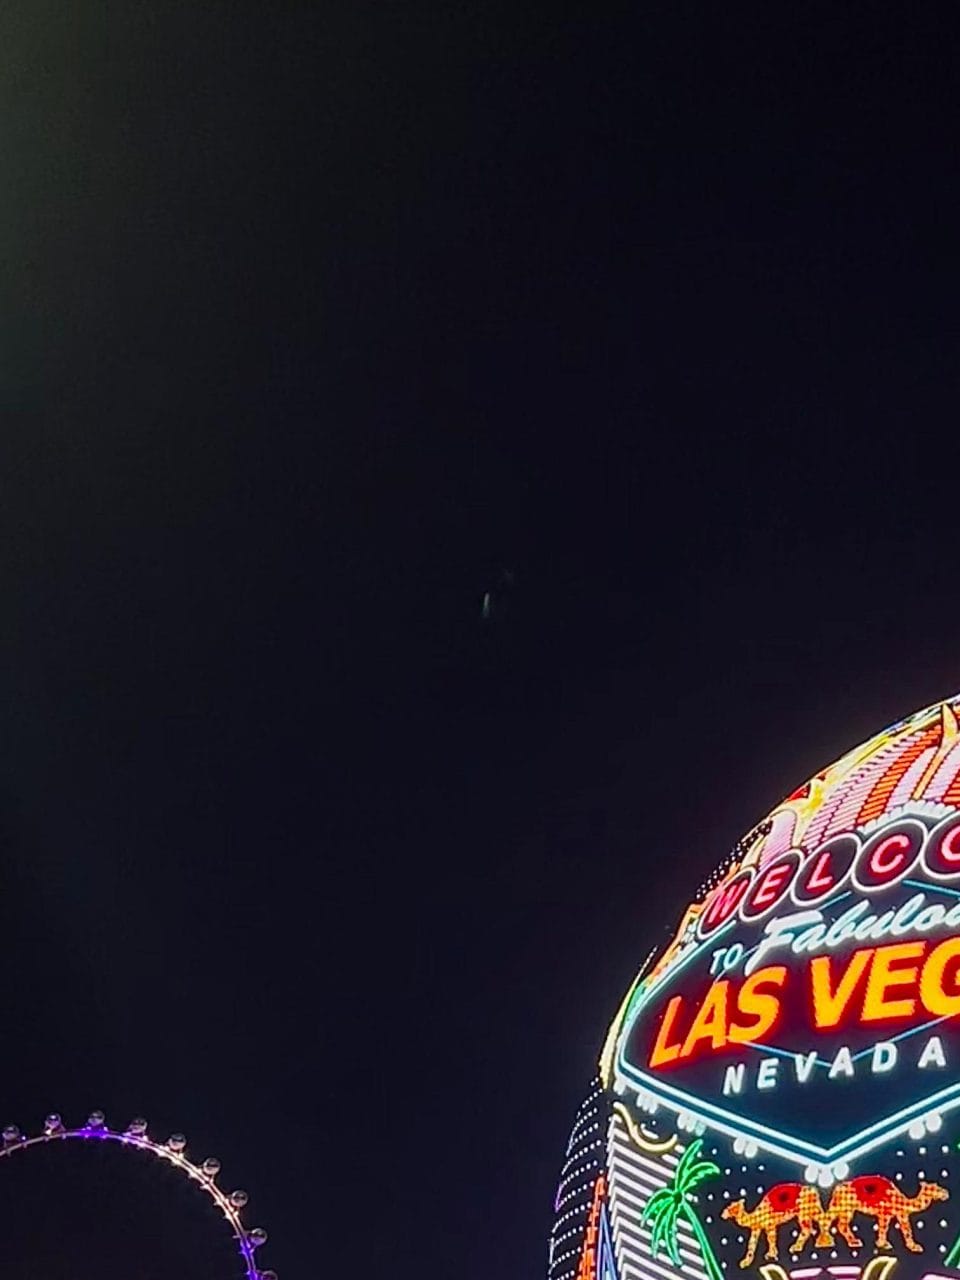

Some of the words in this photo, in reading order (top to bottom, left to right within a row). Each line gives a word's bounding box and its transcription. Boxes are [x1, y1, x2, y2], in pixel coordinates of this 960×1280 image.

[709, 944, 744, 975] TO
[648, 966, 787, 1069] LAS
[723, 1036, 948, 1096] NEVADA
